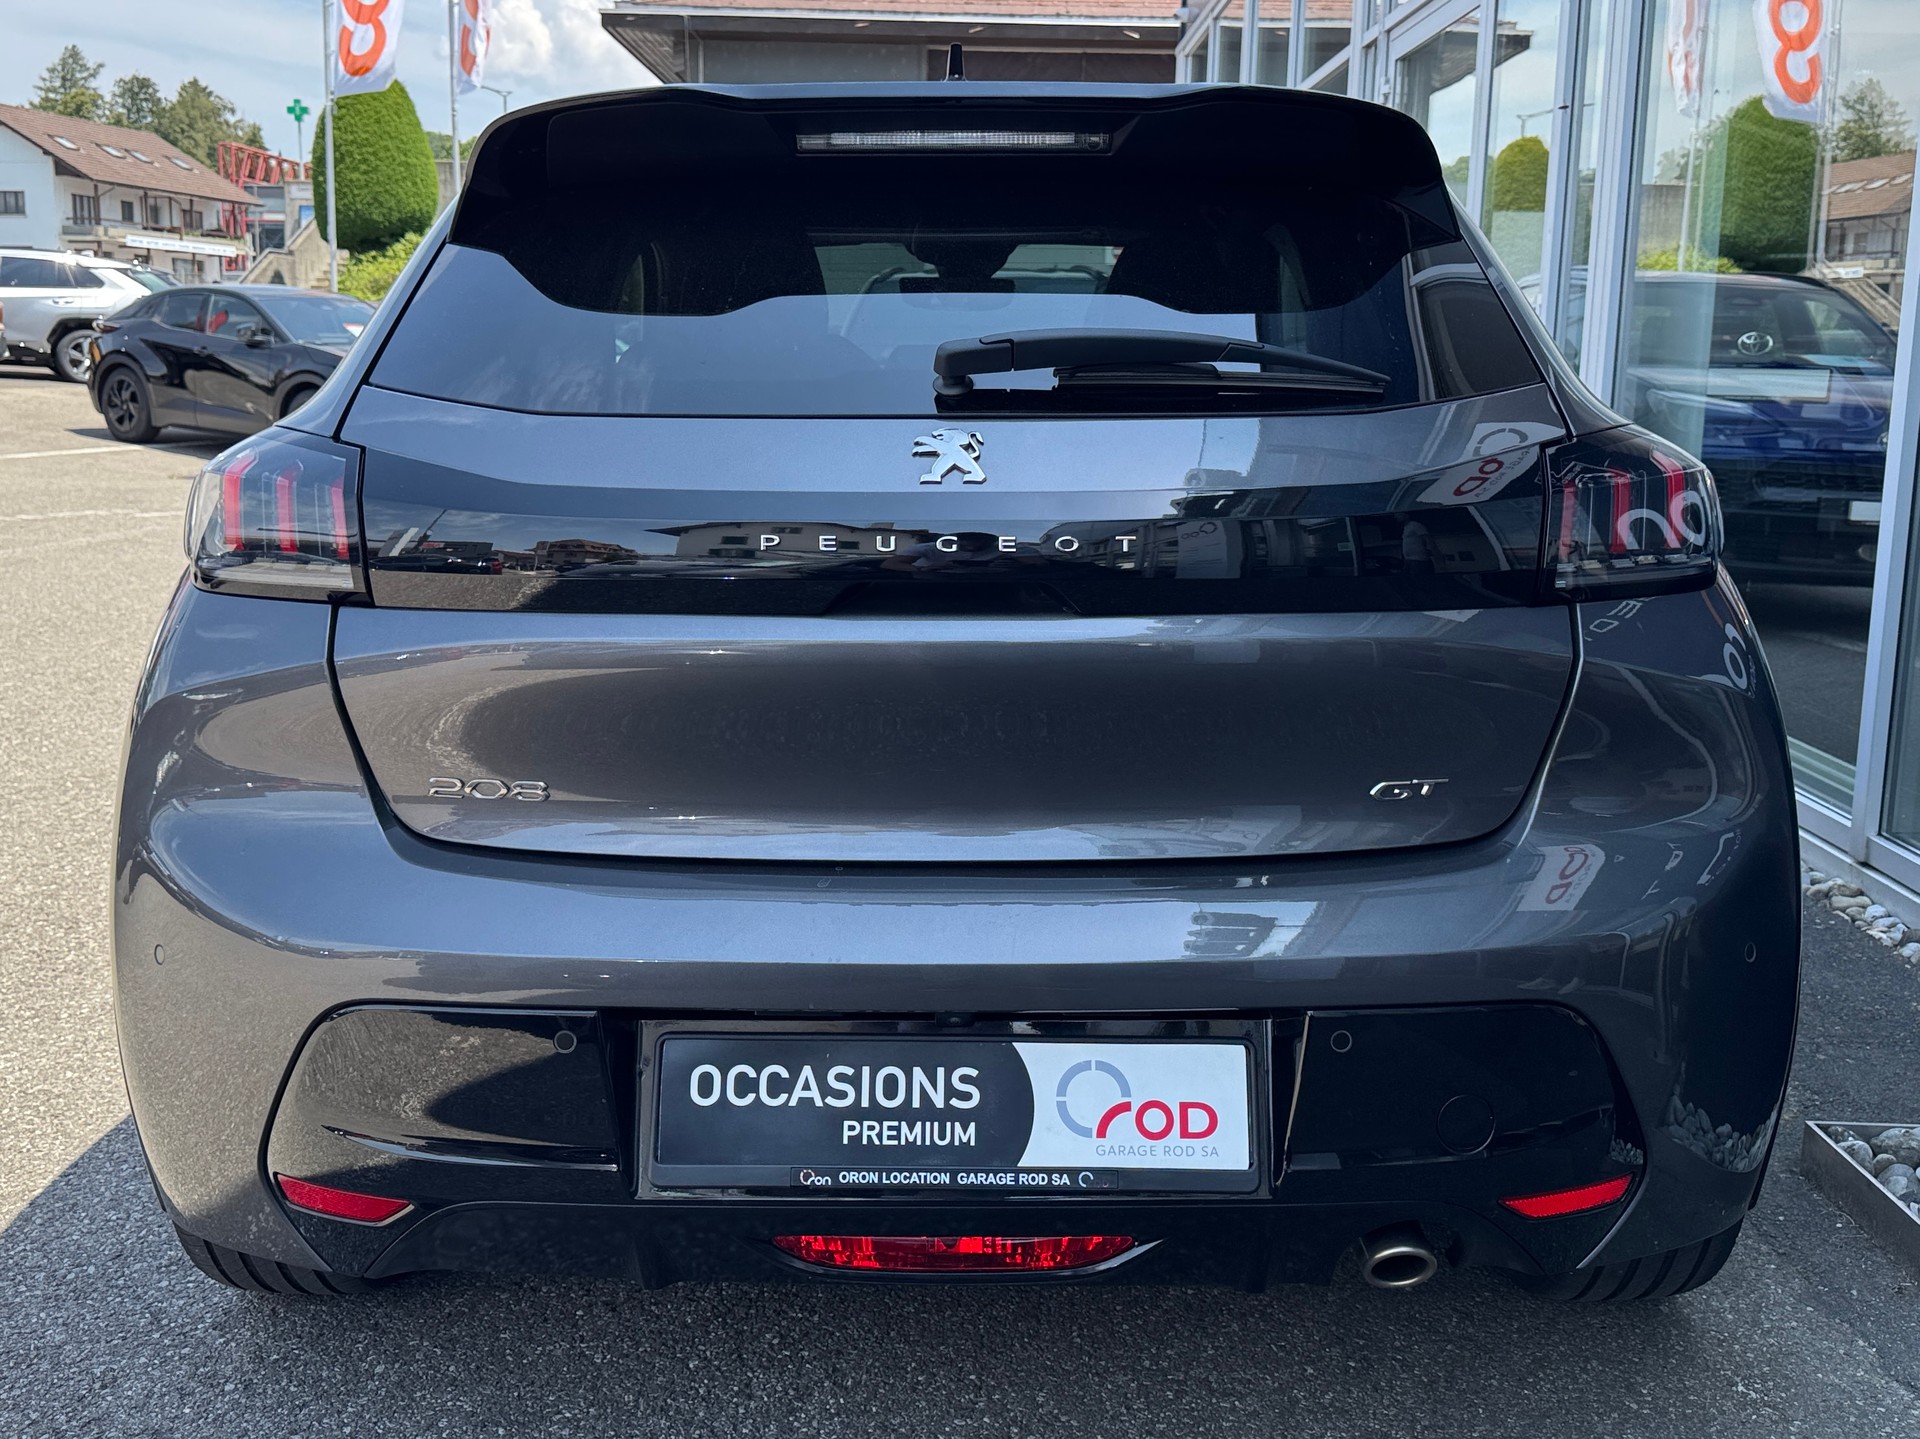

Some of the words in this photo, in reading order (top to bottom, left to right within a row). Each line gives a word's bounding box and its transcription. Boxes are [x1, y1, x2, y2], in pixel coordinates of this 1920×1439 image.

[760, 535, 1137, 552] PEUGEOT
[429, 777, 550, 801] 208
[1369, 779, 1449, 800] GT
[690, 1064, 981, 1109] OCCASIONS
[842, 1120, 976, 1146] PREMIUM
[1096, 1145, 1157, 1156] GARAGE
[1164, 1146, 1195, 1157] ROD
[1201, 1146, 1219, 1157] SA
[839, 1171, 878, 1184] ORON
[882, 1172, 950, 1185] LOCATION
[957, 1172, 1015, 1185] GARAGE
[1019, 1173, 1048, 1186] ROD
[1051, 1173, 1070, 1186] SA
